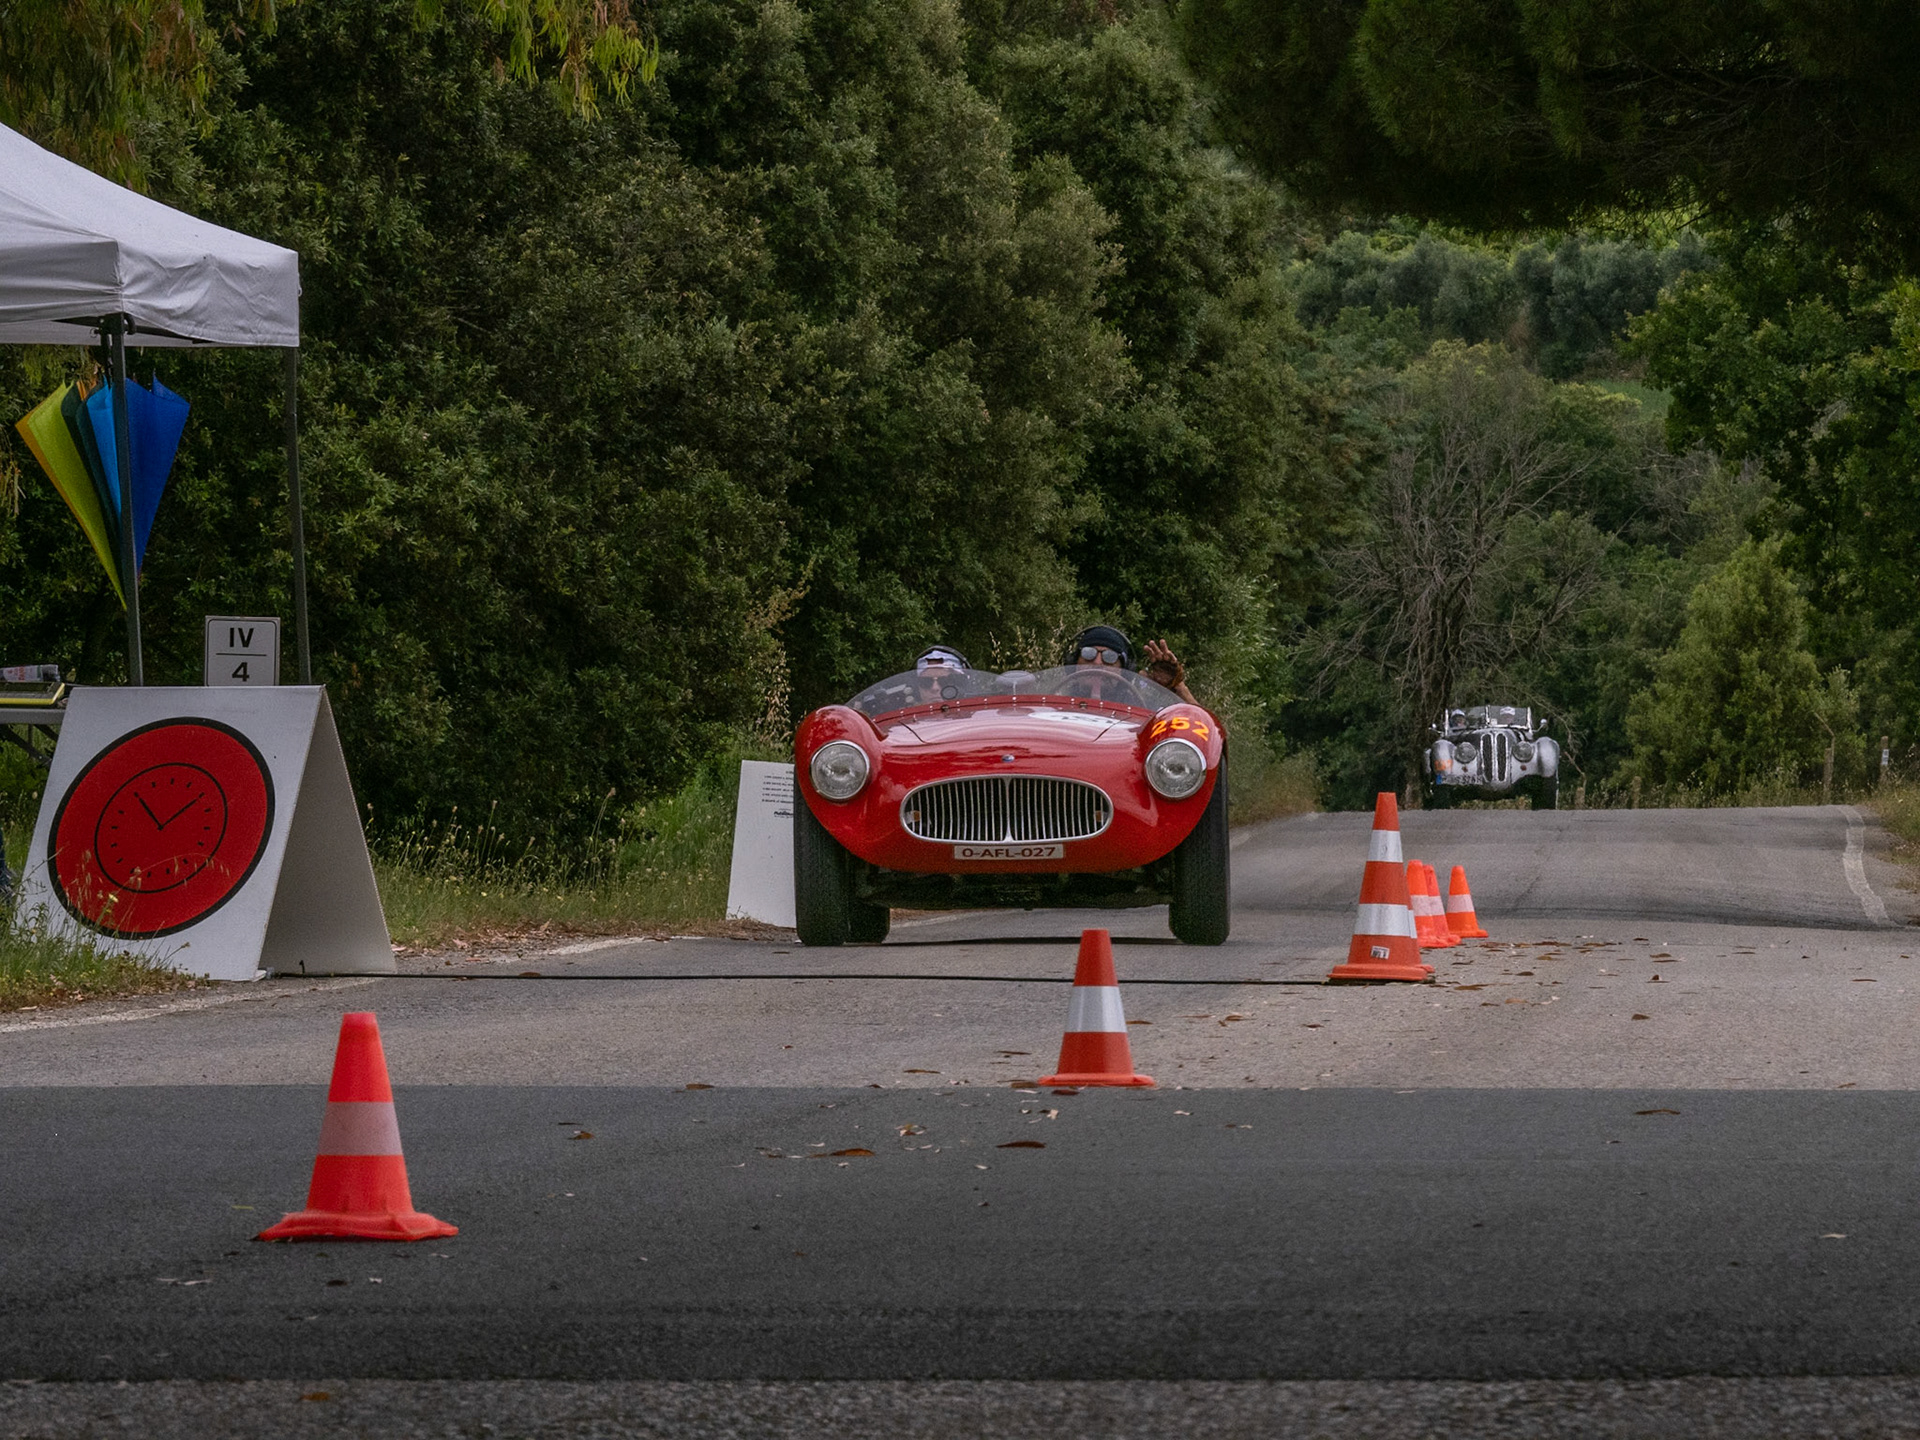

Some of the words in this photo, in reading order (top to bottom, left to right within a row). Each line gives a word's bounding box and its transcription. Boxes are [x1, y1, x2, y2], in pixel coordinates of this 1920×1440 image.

[229, 627, 254, 648] IV
[231, 661, 250, 682] 4
[1150, 716, 1210, 742] 252
